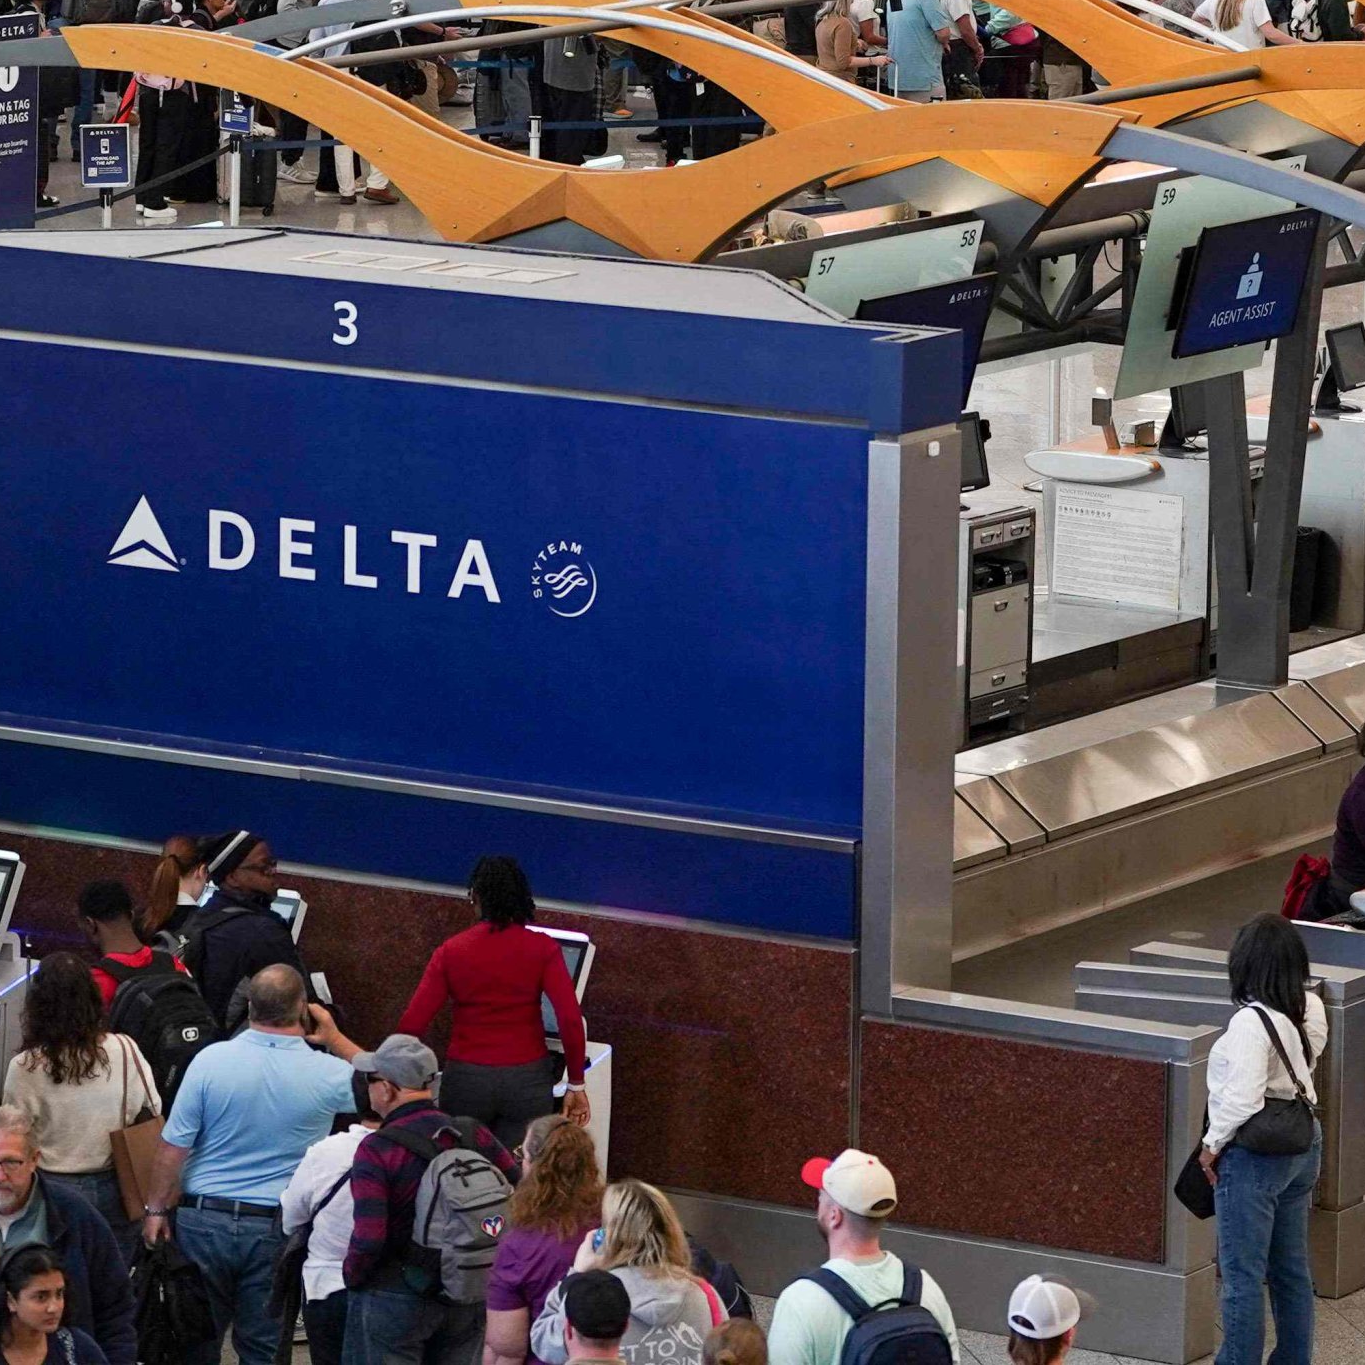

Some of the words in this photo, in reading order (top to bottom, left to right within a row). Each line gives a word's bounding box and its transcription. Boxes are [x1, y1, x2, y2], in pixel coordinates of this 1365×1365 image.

[4, 67, 11, 85] 1
[6, 102, 13, 112] &
[13, 99, 31, 110] TAG
[8, 112, 29, 124] BAGS
[1161, 187, 1176, 206] 59
[1286, 221, 1308, 232] DELTA
[960, 229, 977, 248] 58
[818, 256, 836, 276] 57
[956, 289, 981, 302] DELTA
[332, 301, 358, 346] 3
[1208, 307, 1243, 328] AGENT
[1243, 301, 1276, 321] ASSIST
[208, 509, 501, 604] DELTA
[531, 540, 582, 598] SKYTEAM
[645, 1339, 676, 1359] TO
